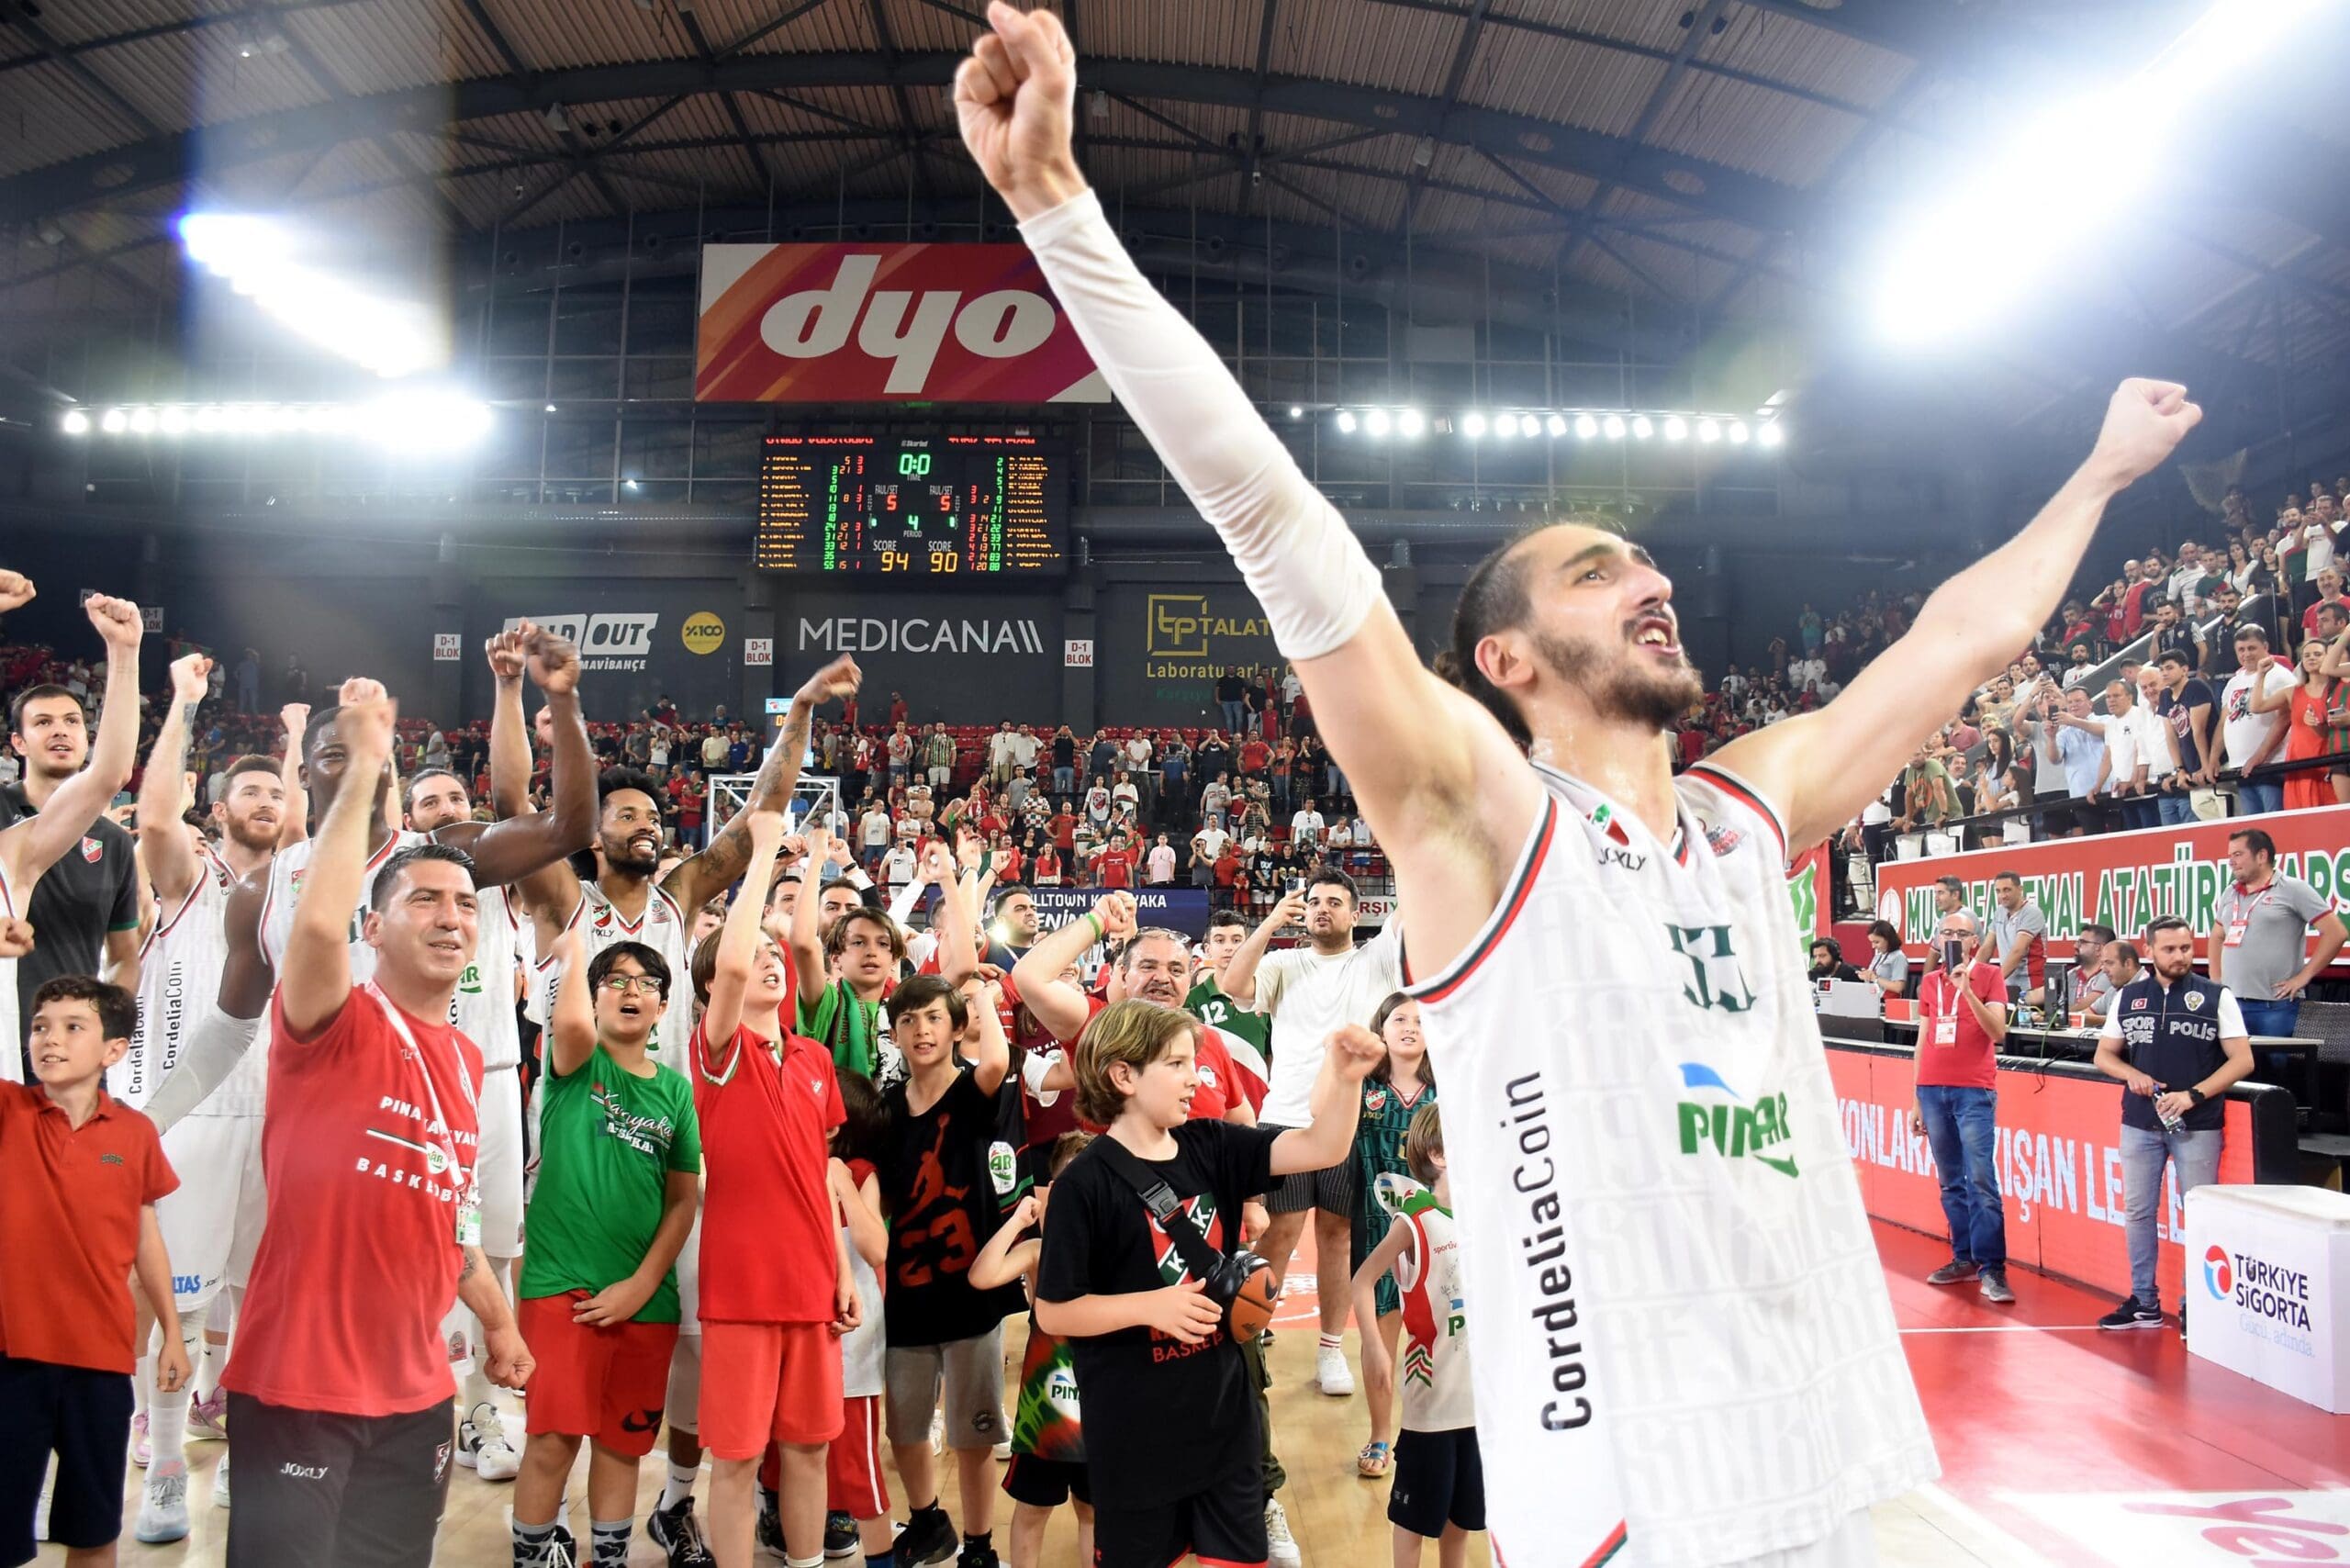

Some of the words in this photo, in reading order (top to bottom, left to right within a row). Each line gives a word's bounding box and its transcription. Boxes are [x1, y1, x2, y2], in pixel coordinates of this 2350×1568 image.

[760, 254, 1057, 394] dyo
[887, 495, 898, 510] 5
[940, 495, 951, 511] 5
[908, 515, 919, 530] 4
[903, 530, 923, 538] PERIOD
[873, 540, 897, 551] SCORE
[928, 541, 952, 552] SCORE
[881, 552, 909, 572] 94
[931, 553, 958, 572] 90
[592, 623, 644, 646] OUT
[799, 618, 1023, 654] MEDICANA
[435, 647, 459, 658] BLOK
[745, 653, 772, 665] BLOK
[1066, 654, 1091, 666] BLOK
[1147, 662, 1277, 678] Laboratuarlr
[1201, 1001, 1228, 1025] 12
[2169, 1021, 2217, 1041] POLİS
[1677, 1091, 1792, 1158] PINAR
[1500, 1071, 1592, 1431] CordeliaCoin
[2234, 1253, 2309, 1301] TÜRKİYE
[2236, 1282, 2311, 1332] SİGORTA
[1051, 1384, 1080, 1401] PIN
[280, 1462, 329, 1480] JOXLY
